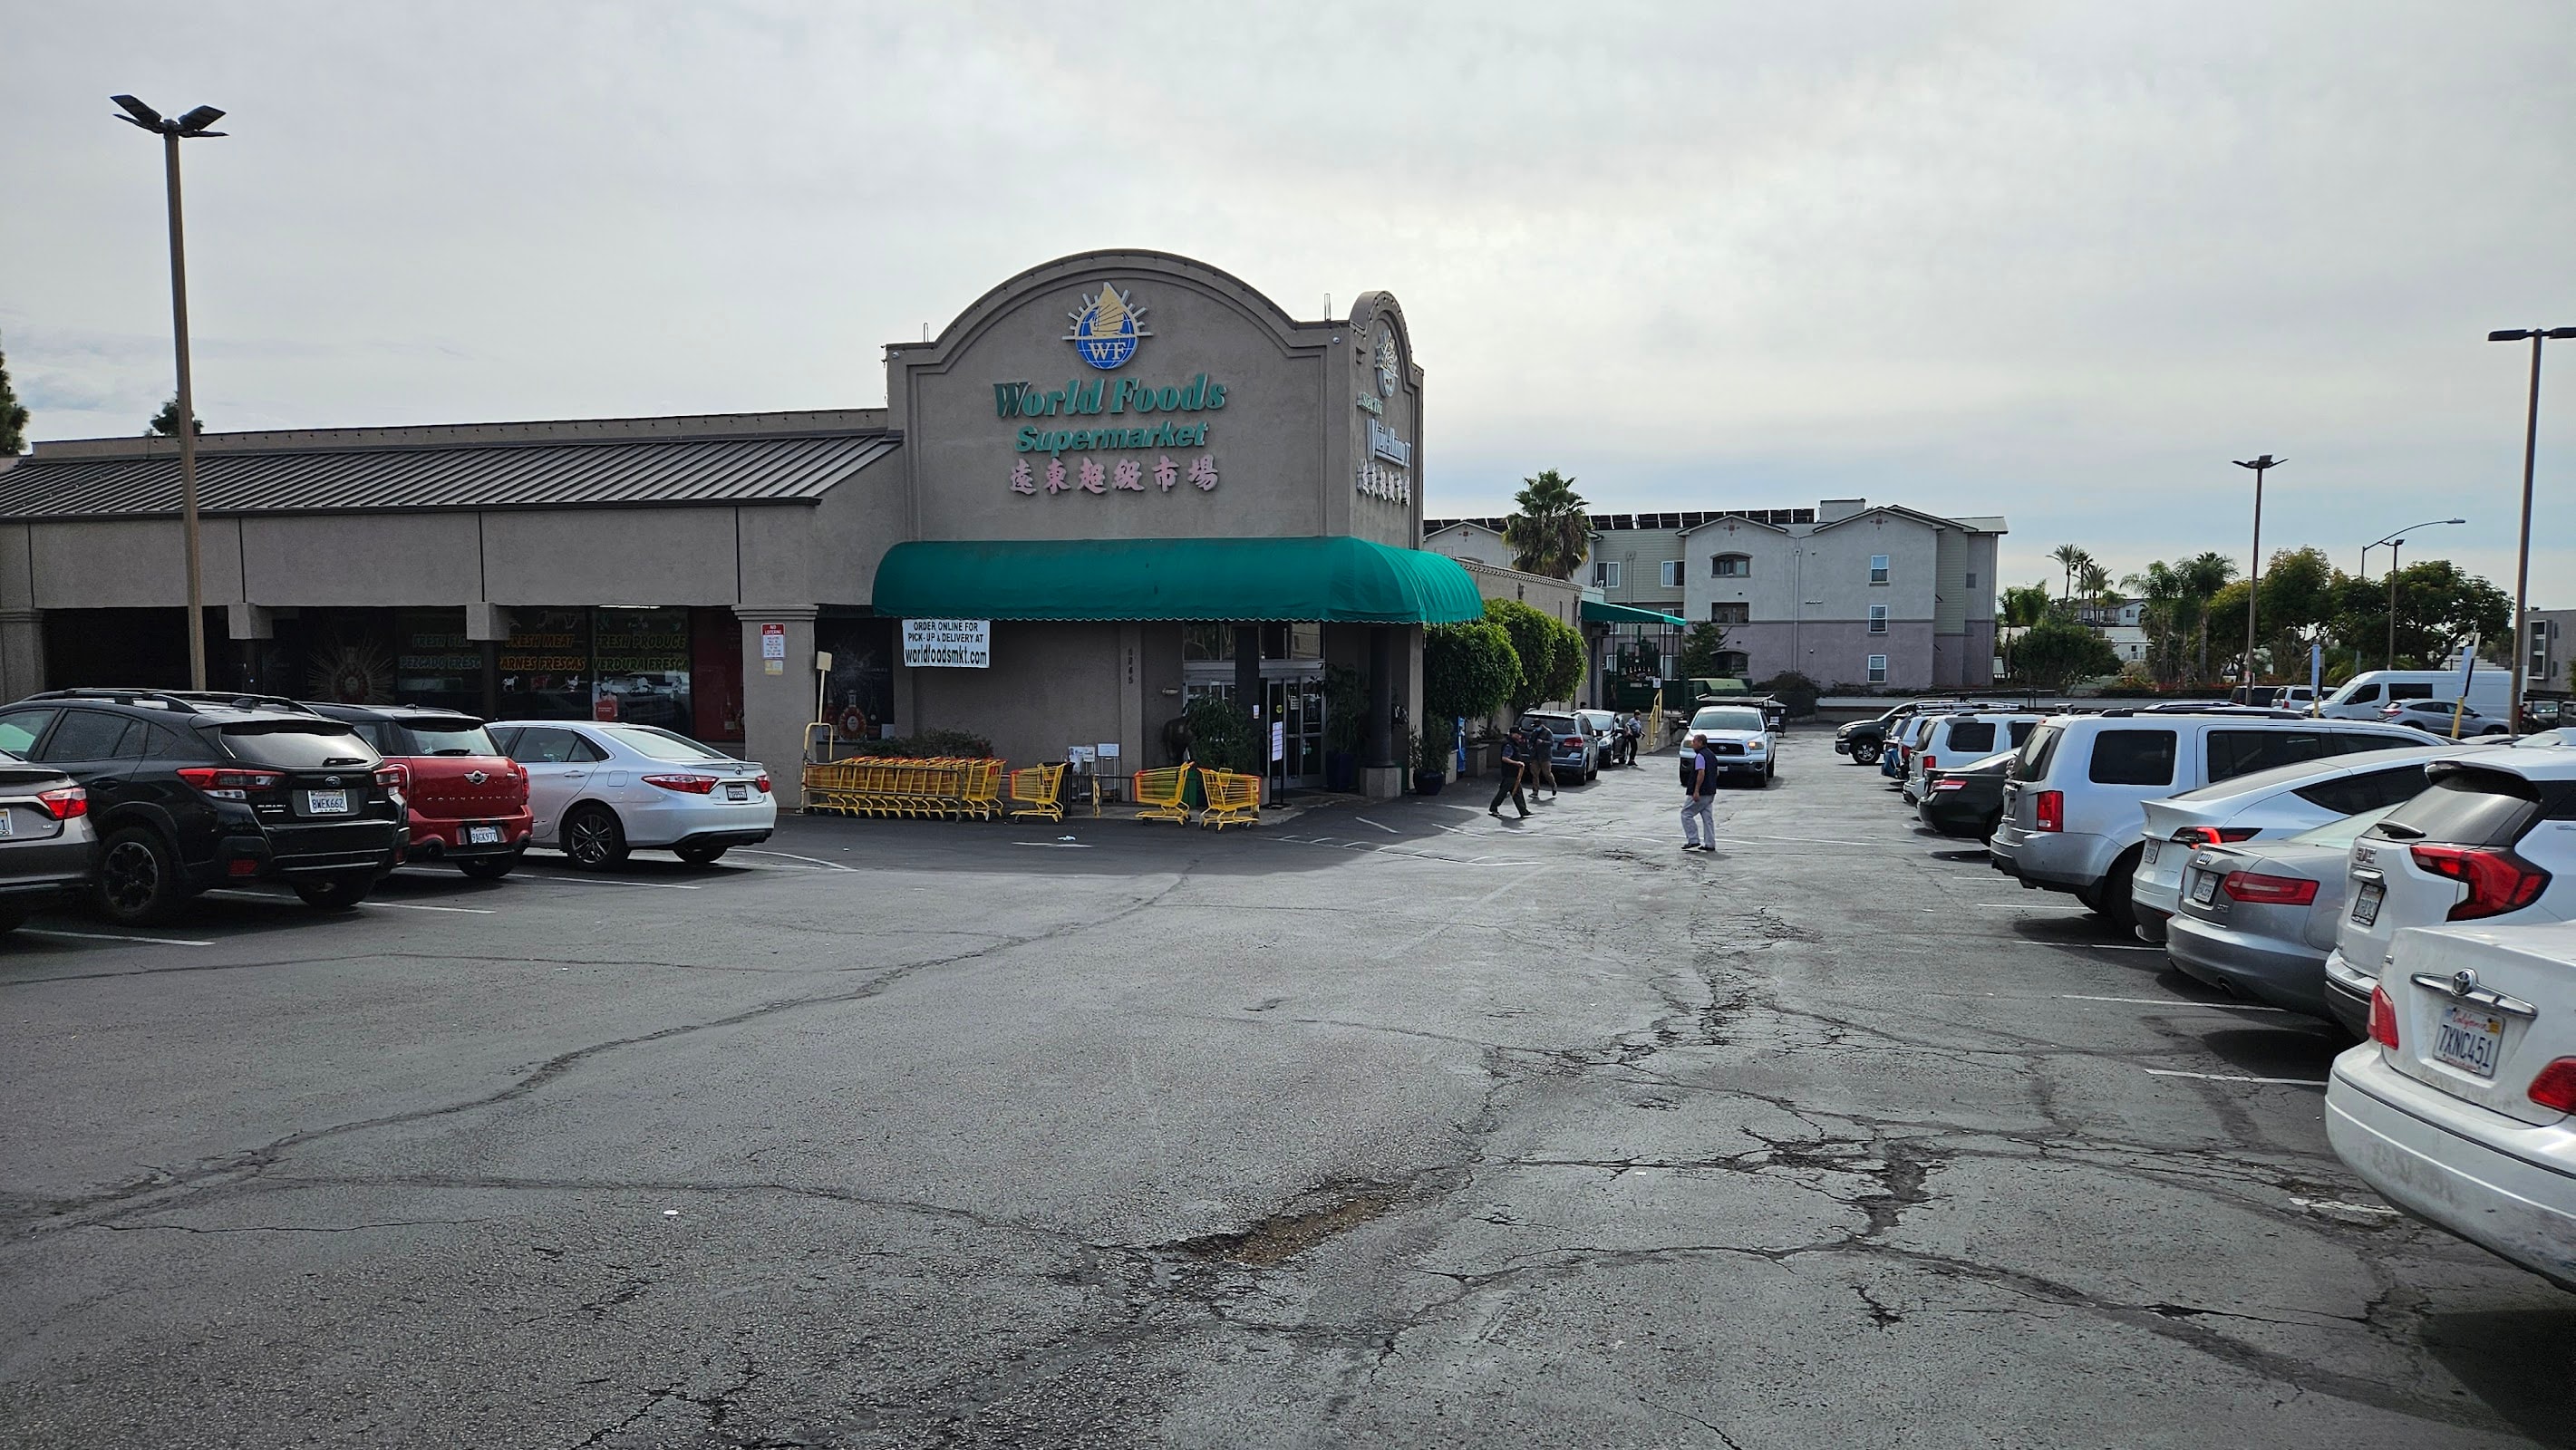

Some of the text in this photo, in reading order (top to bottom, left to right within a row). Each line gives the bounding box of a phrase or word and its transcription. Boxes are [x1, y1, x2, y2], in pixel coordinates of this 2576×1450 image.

[1088, 343, 1127, 361] WF
[993, 372, 1227, 418] World Foods
[1014, 420, 1209, 459] Supermarket
[1010, 454, 1220, 495] 遠東超級市場
[913, 622, 978, 632] ORDER ONLINE FOR
[413, 634, 446, 647] FRESH
[505, 633, 576, 648] FRESH MEAT
[595, 633, 687, 649] FRESH PRODUCE
[942, 633, 974, 643] DELIVERY
[975, 633, 983, 643] AT
[905, 644, 987, 665] worldfoodsmkt.com
[499, 656, 586, 671] ARNES FRESCAS
[593, 657, 646, 672] VERDURA
[312, 798, 344, 808] 8WEK662
[2438, 1024, 2493, 1068] 7XNC451
